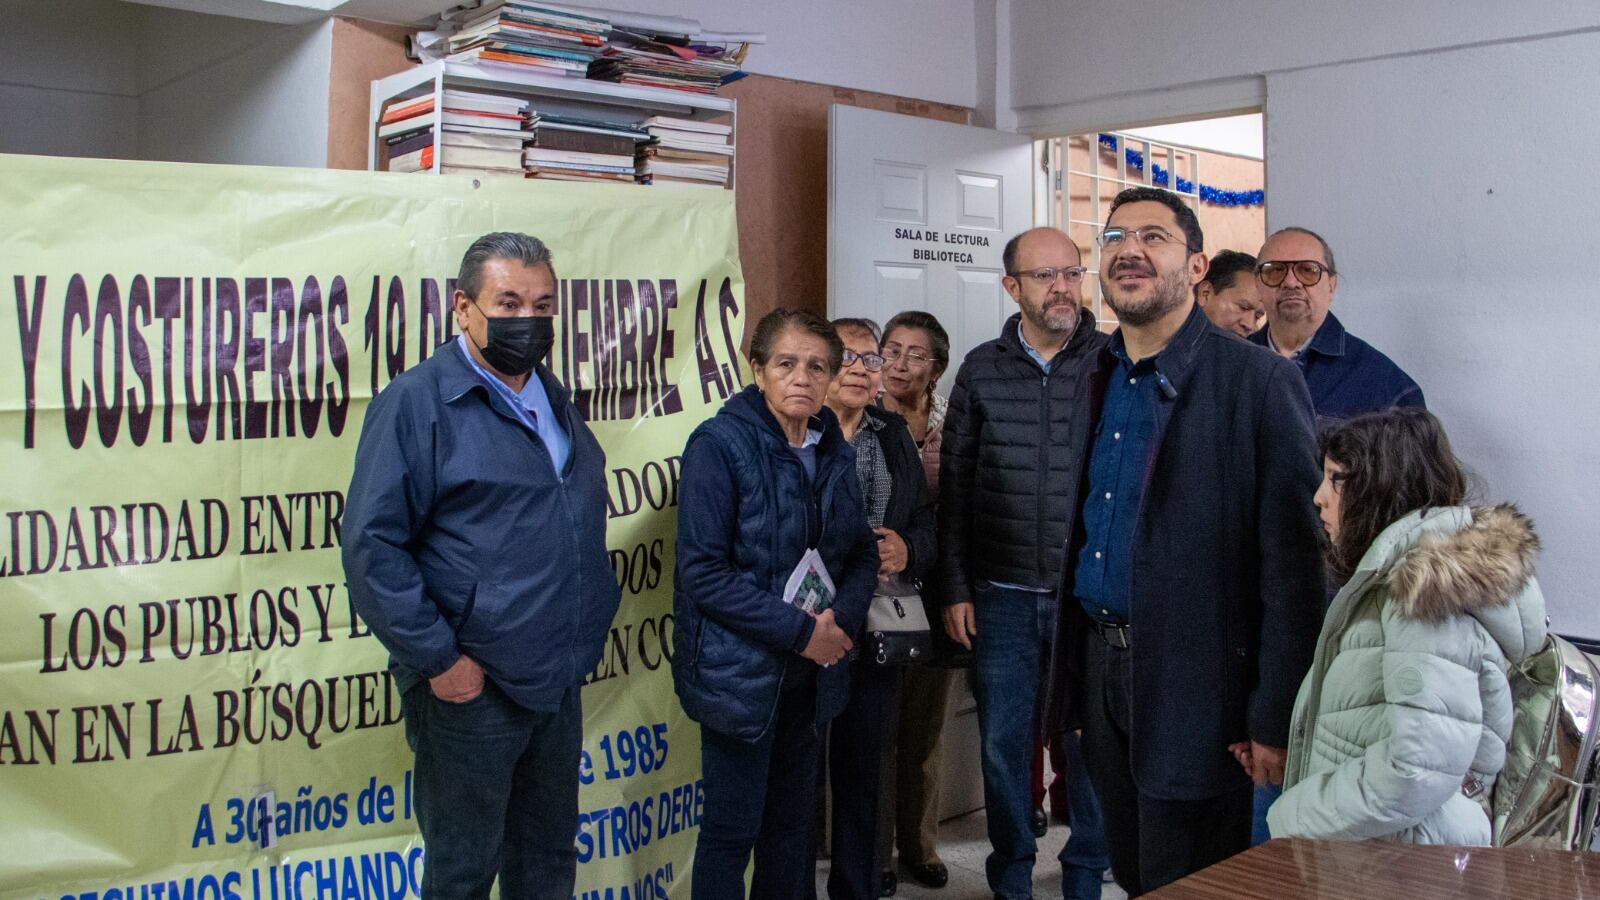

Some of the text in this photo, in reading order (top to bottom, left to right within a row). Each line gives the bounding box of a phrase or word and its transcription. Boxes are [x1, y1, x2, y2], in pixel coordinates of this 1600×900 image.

[894, 228, 990, 247] SALA DE LECTURA
[913, 248, 974, 264] BIBLIOTECA
[13, 274, 47, 449] Y
[61, 272, 350, 450] COSTUREROS
[39, 605, 127, 674] LOS
[138, 586, 301, 663] PUBLOS
[306, 583, 336, 642] Y
[72, 701, 135, 763] EN
[146, 694, 205, 757] LA
[191, 803, 216, 849] A
[275, 785, 349, 837] años
[357, 776, 395, 825] de
[600, 722, 669, 781] 1985
